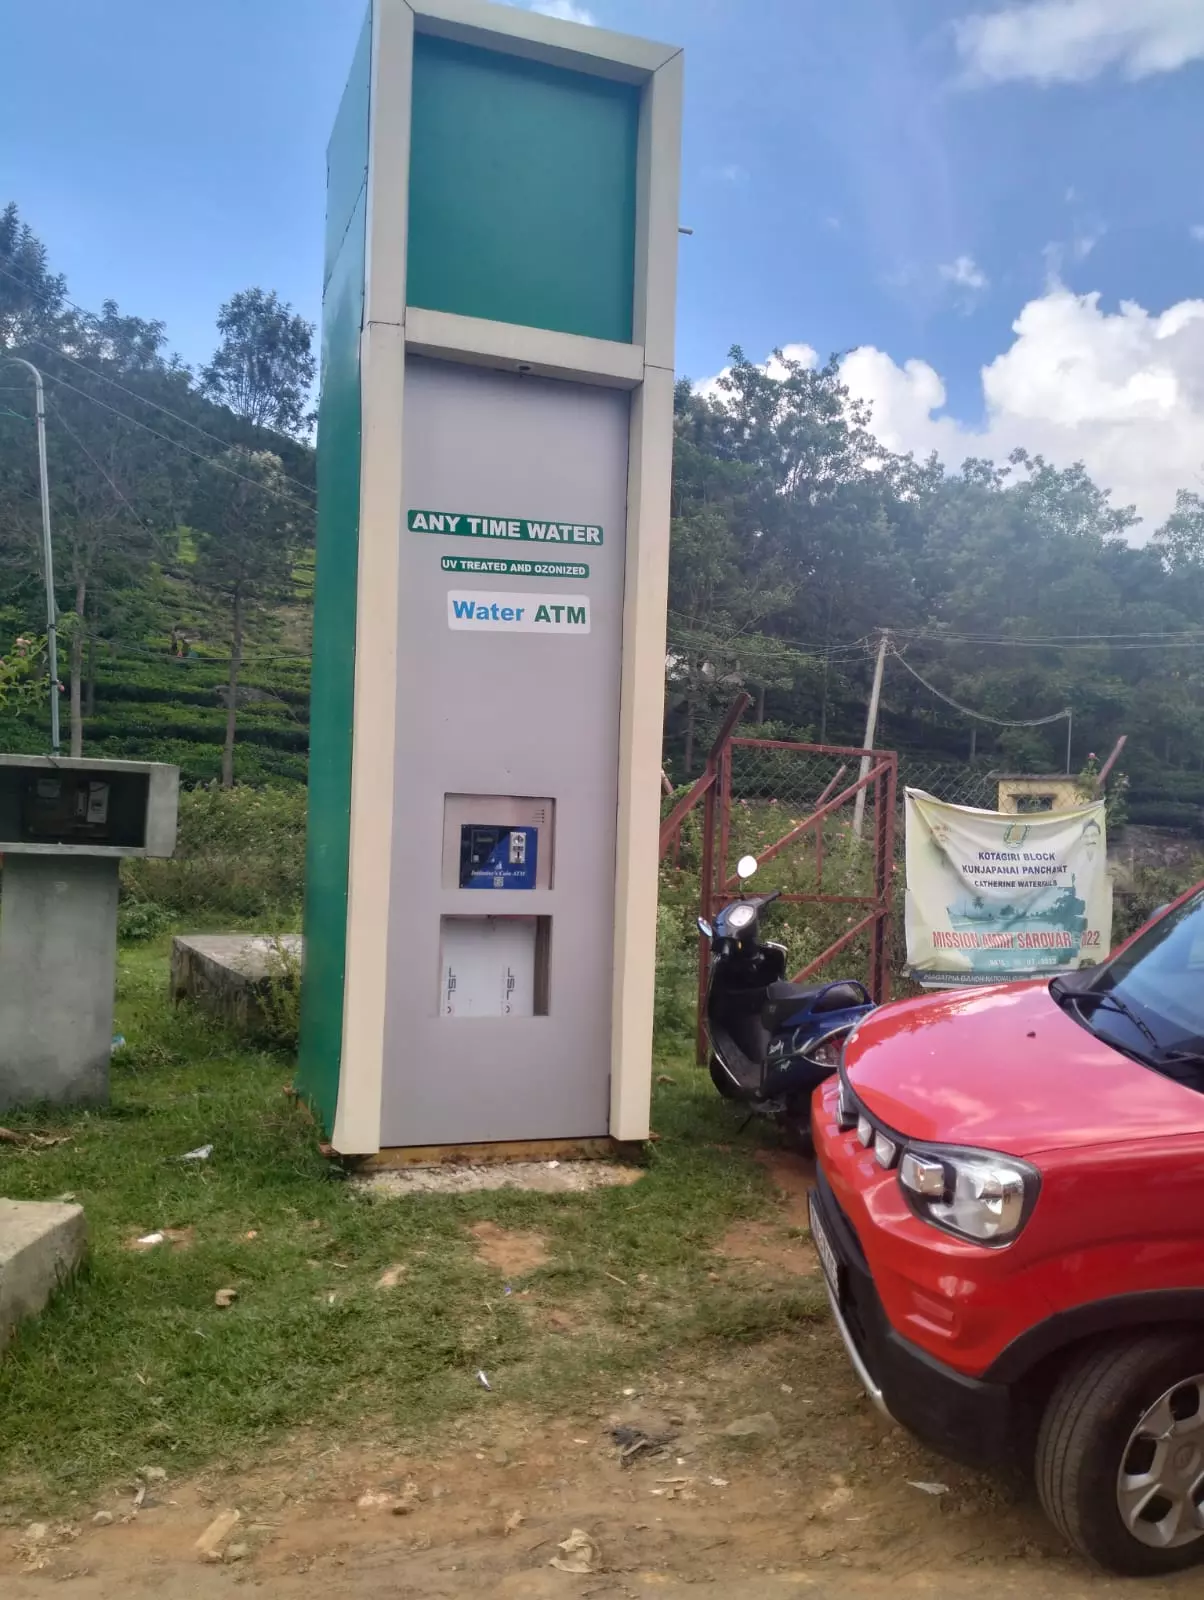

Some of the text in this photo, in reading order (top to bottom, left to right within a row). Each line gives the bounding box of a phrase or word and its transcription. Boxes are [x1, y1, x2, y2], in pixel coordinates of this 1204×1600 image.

[411, 513, 600, 543] ANY TIME WATER
[442, 559, 586, 576] UV TREATED AND OZONIZED
[452, 599, 586, 625] Water ATM
[978, 851, 1056, 861] KOTAGIRI BLOCK
[961, 864, 1019, 875] KUNJAPANAI
[974, 880, 1016, 888] CATHERINE
[932, 931, 981, 949] MISSION
[1017, 931, 1072, 949] SAROVAR
[447, 967, 457, 1001] JSL
[506, 967, 515, 1001] JSL
